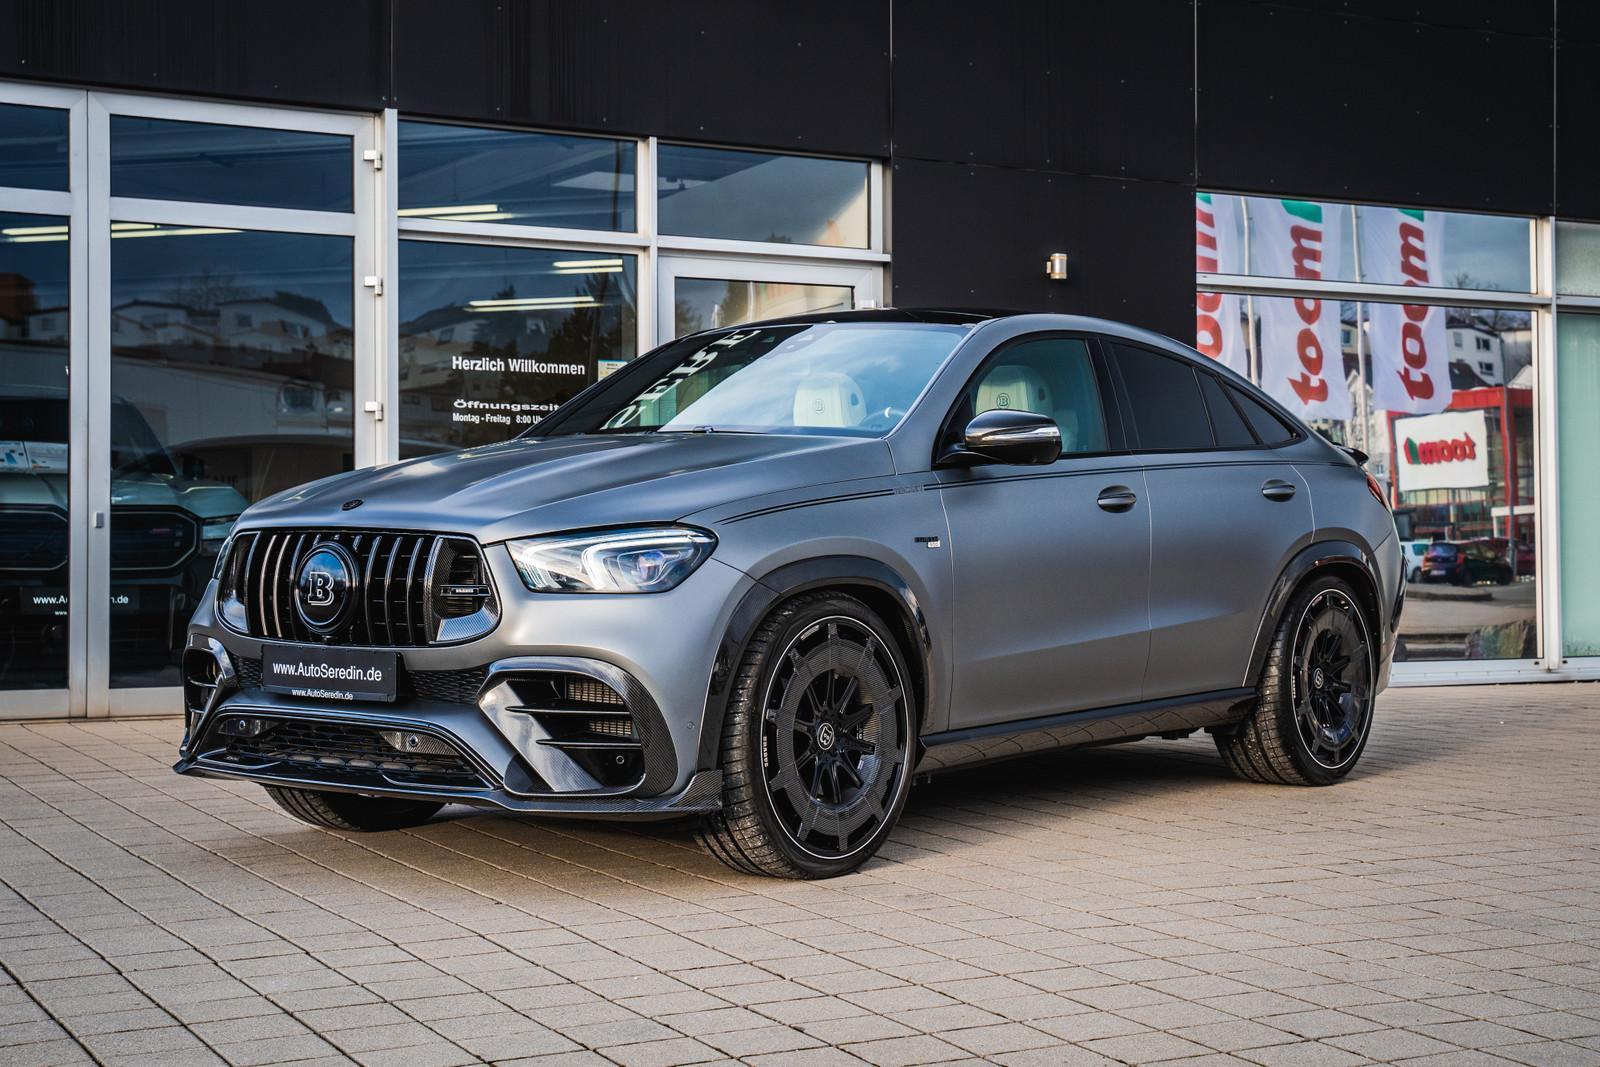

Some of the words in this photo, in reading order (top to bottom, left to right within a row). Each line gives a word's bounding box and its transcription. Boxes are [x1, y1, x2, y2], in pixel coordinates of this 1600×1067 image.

[452, 355, 505, 372] Herzlich
[508, 358, 585, 375] Willkommen
[453, 399, 560, 412] Öffnungszeit
[452, 412, 480, 424] Montag
[485, 413, 511, 425] Freitag
[515, 415, 531, 424] 8:00
[532, 415, 543, 425] Uh
[307, 571, 335, 606] B
[272, 661, 382, 682] www.AutoSeredin.de
[291, 688, 354, 701] www.AutoSeredin.de
